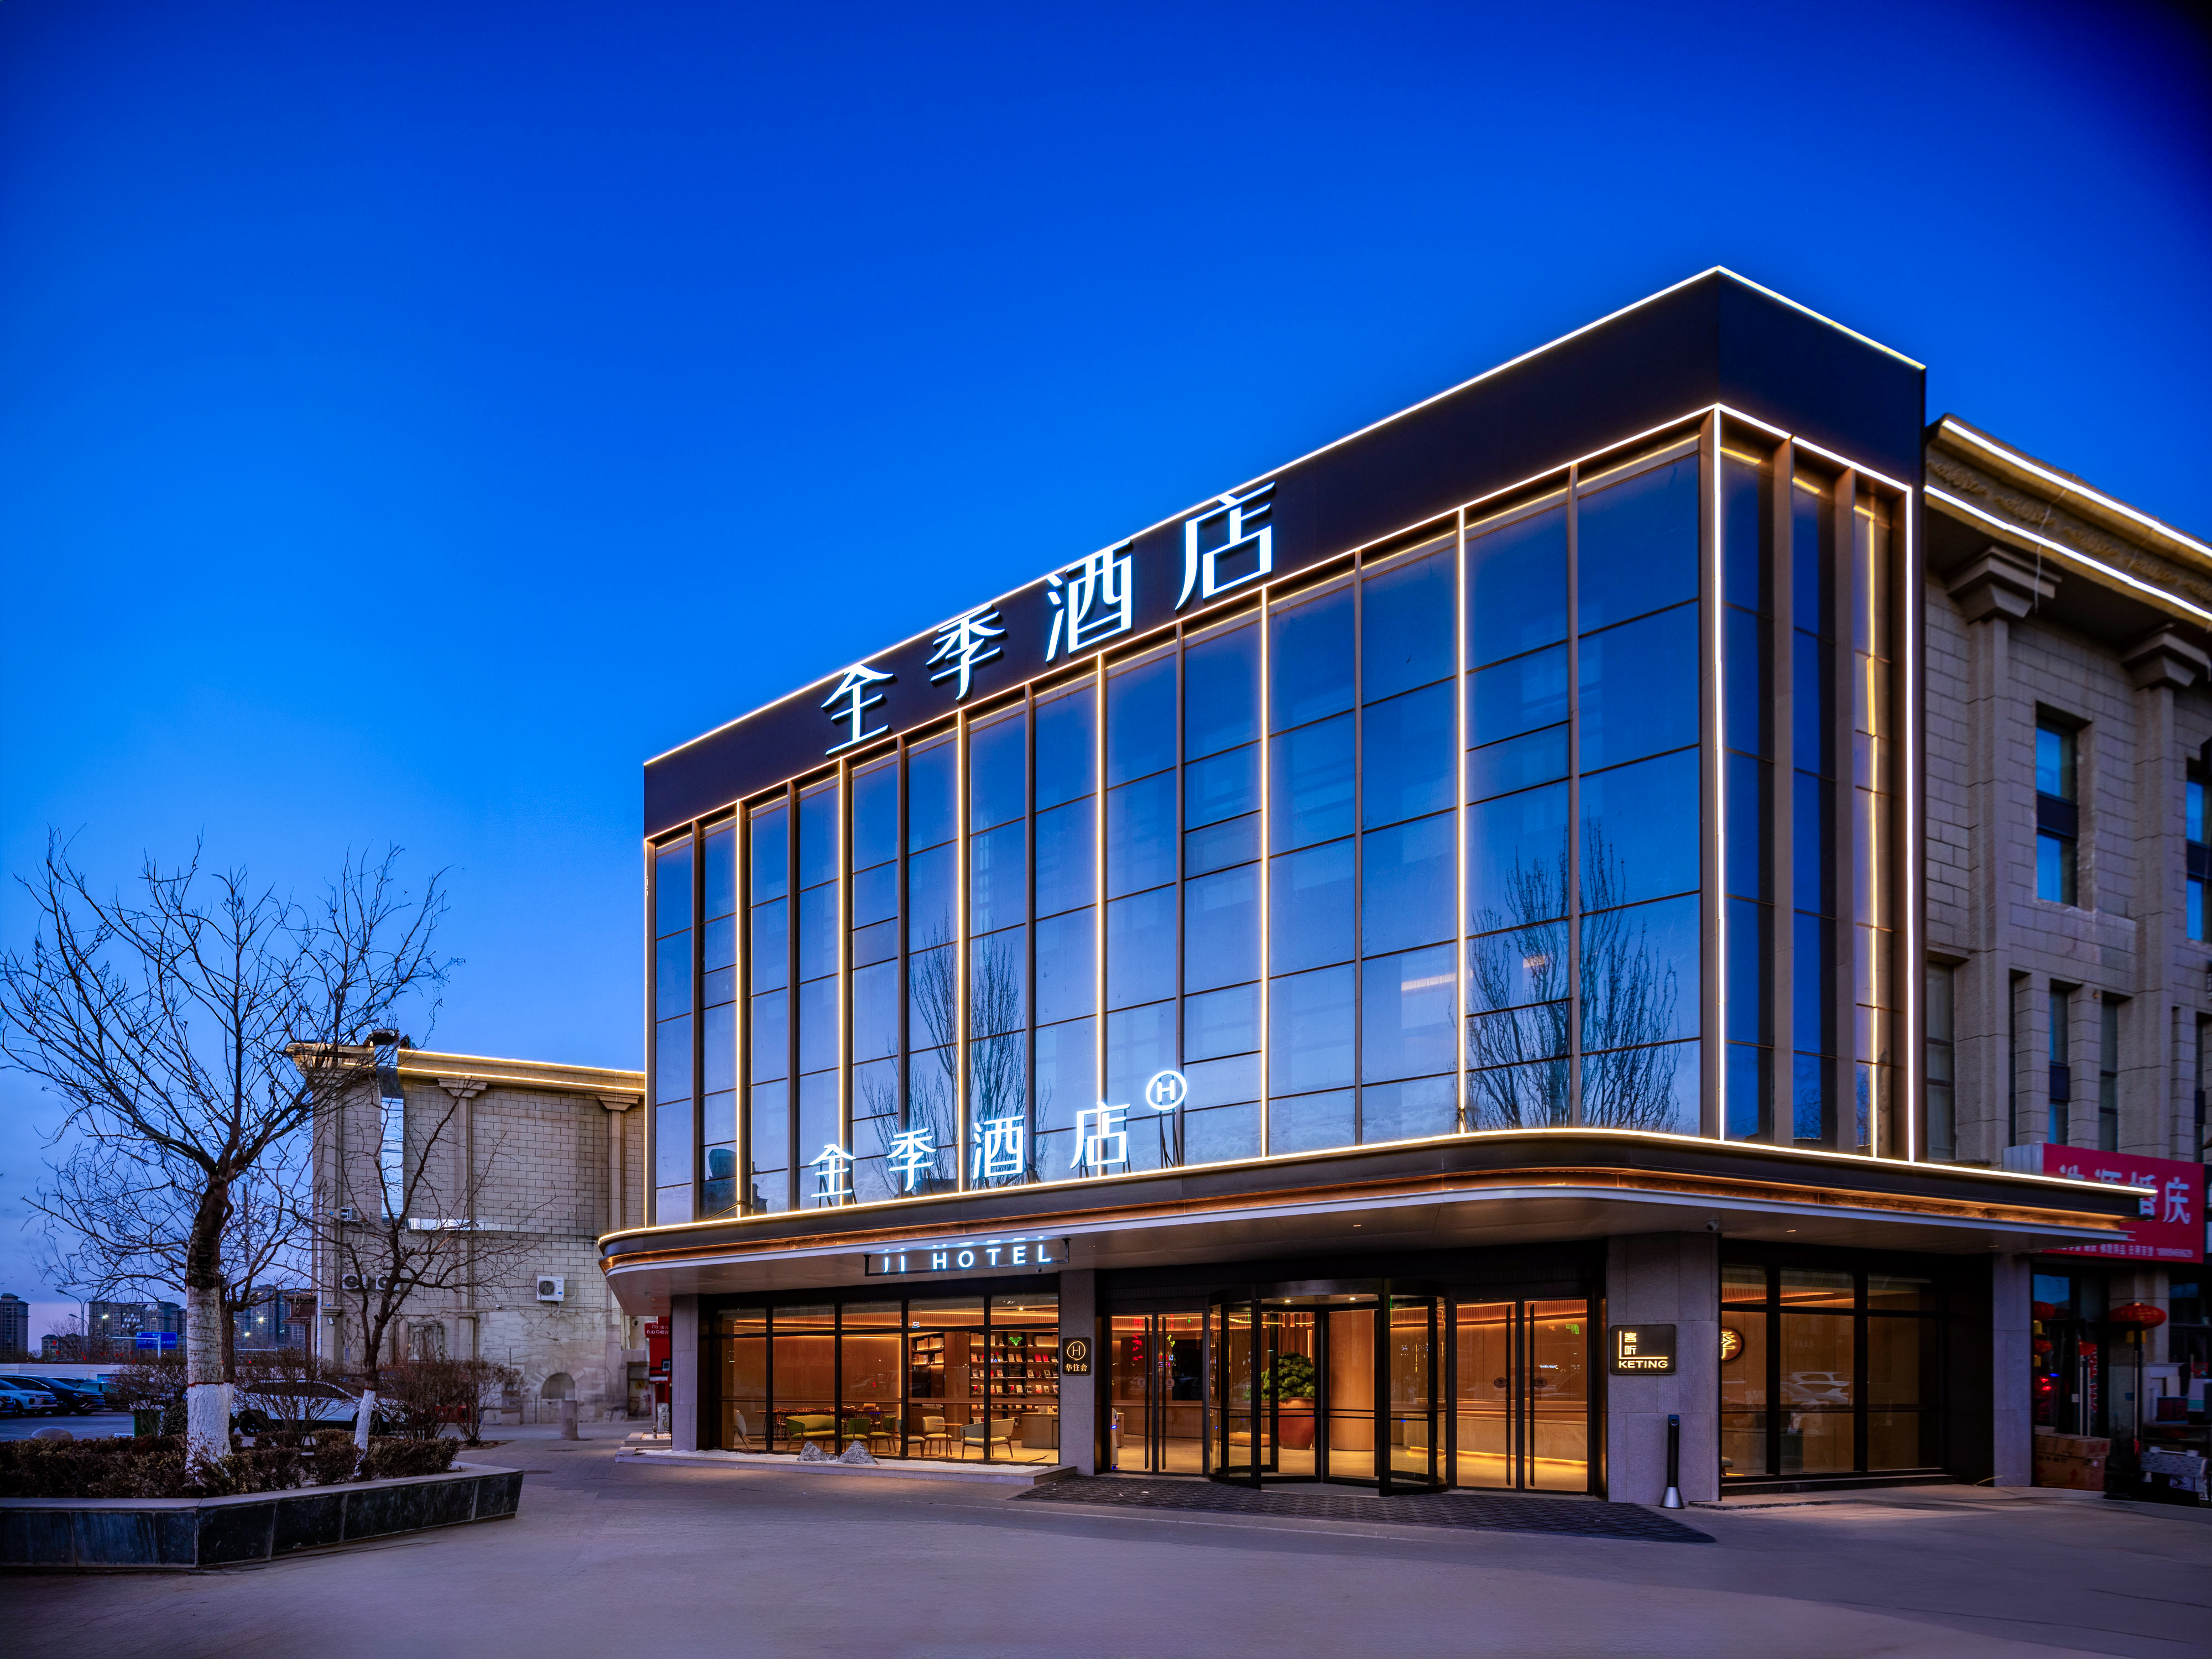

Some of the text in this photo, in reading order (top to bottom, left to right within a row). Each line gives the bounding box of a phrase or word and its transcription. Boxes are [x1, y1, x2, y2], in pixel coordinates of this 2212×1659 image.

[821, 481, 1276, 756] 全季酒店
[808, 1101, 1131, 1198] 全季酒店
[883, 1244, 1052, 1273] JI HOTEL
[1065, 1363, 1087, 1372] 华住会
[1618, 1360, 1668, 1369] KETING
